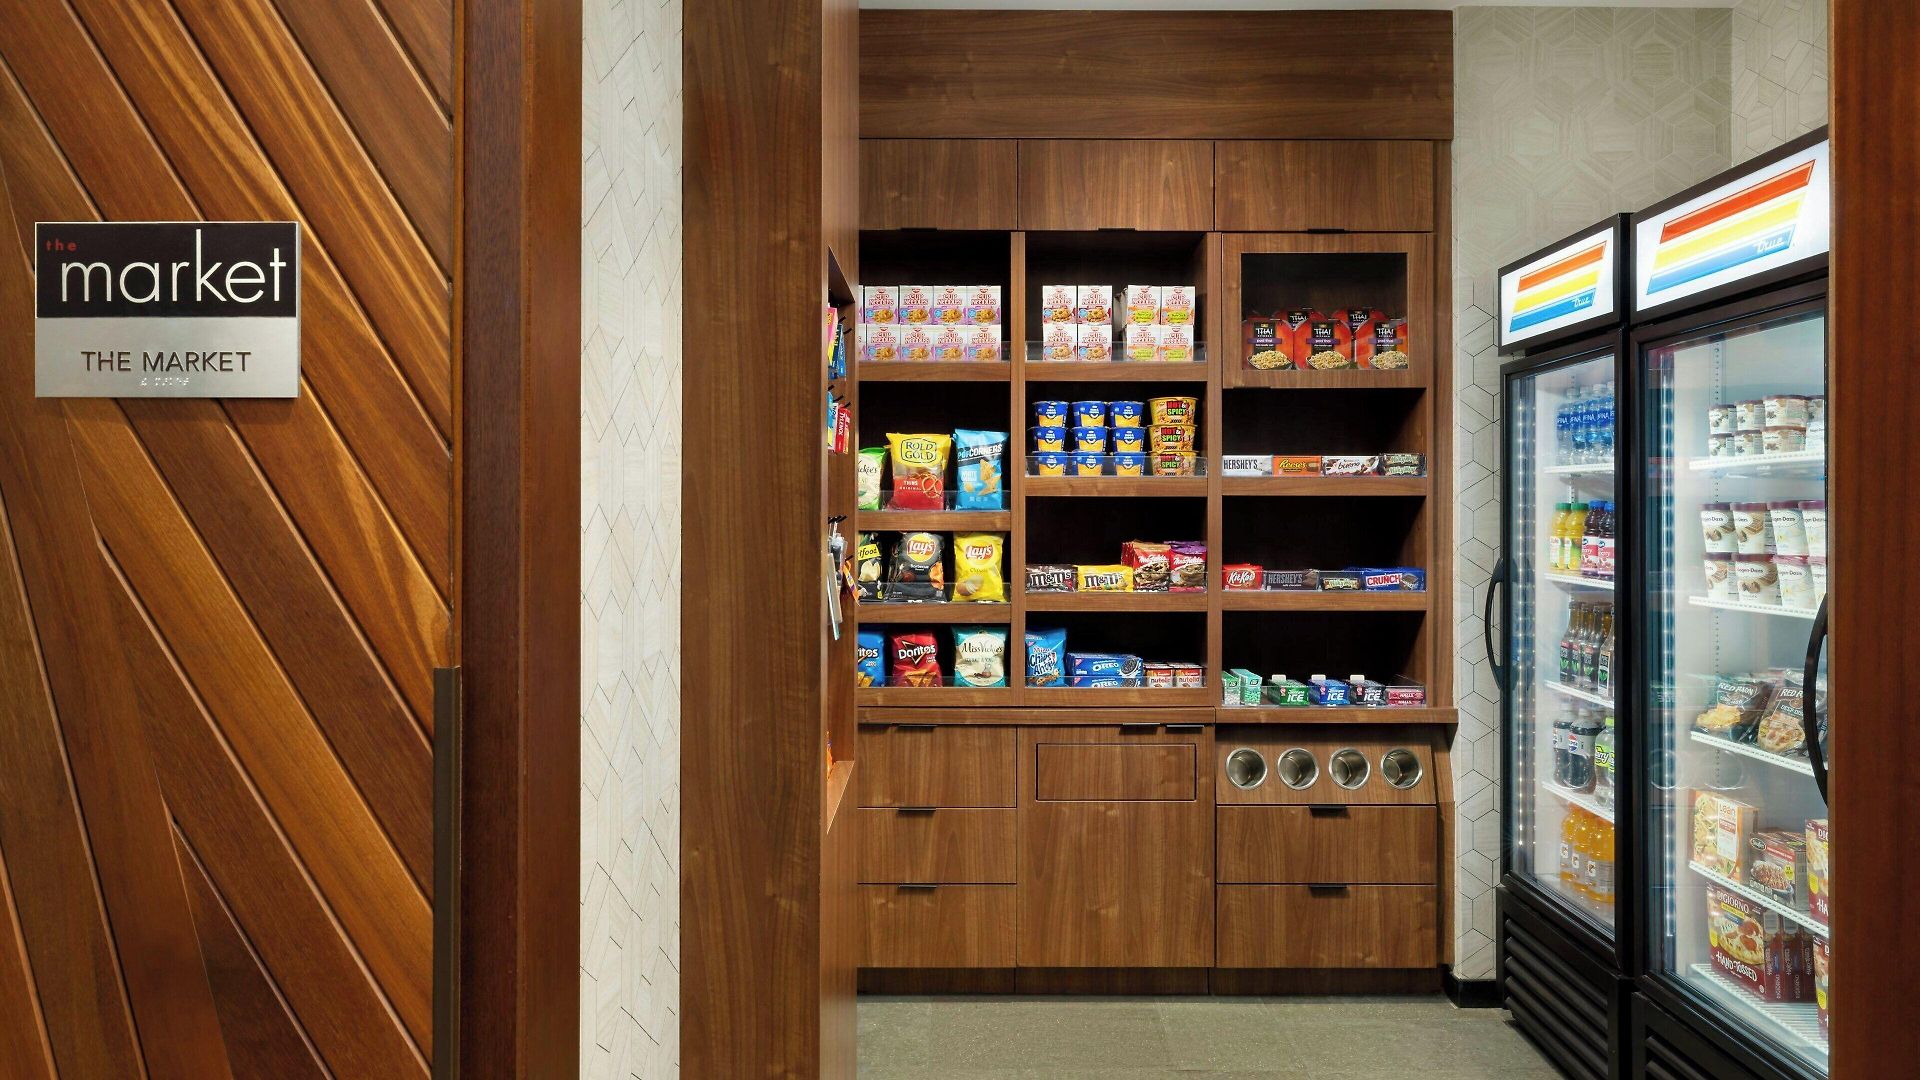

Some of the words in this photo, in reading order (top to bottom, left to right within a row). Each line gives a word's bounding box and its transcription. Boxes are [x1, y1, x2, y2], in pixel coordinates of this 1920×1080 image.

[46, 240, 77, 251] the
[62, 229, 287, 303] market
[81, 352, 132, 372] THE
[143, 351, 252, 373] MARKET
[905, 441, 933, 451] ROLD
[905, 450, 934, 460] GOLD
[1224, 460, 1258, 470] HERSHEY'S
[908, 541, 934, 555] Lay's
[967, 545, 992, 560] Lay's
[1269, 574, 1303, 583] HERSHEY'S
[1367, 575, 1401, 586] CRUNCH
[898, 645, 936, 660] Doritos
[962, 643, 980, 652] Miss
[1030, 652, 1052, 666] Chips
[1092, 663, 1119, 672] OREO
[1780, 689, 1796, 697] RED
